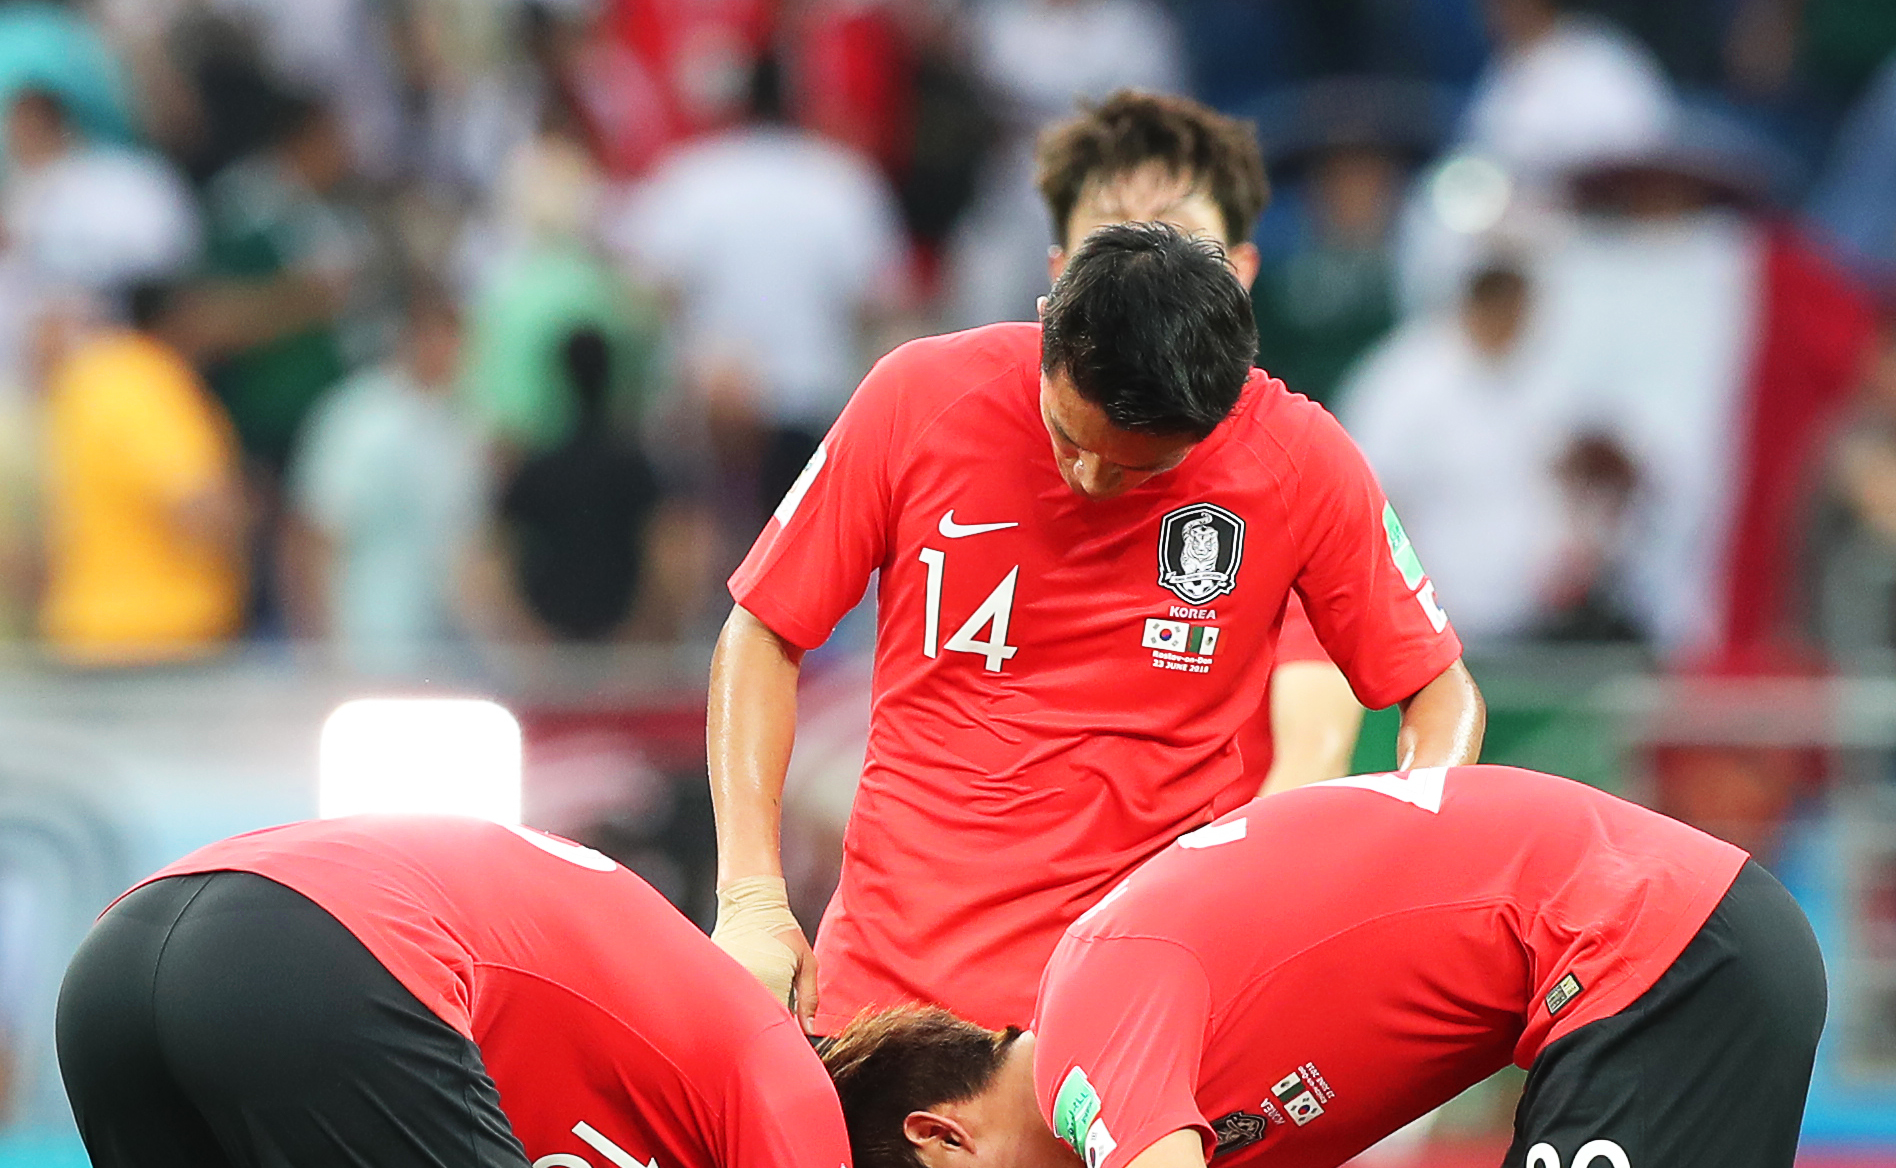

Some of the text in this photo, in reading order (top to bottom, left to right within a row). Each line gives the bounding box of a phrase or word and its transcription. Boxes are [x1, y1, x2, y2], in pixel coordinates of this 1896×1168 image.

[918, 547, 1019, 672] 14
[1169, 605, 1216, 620] KOREA
[1152, 659, 1210, 673] 23 JUNE 2018
